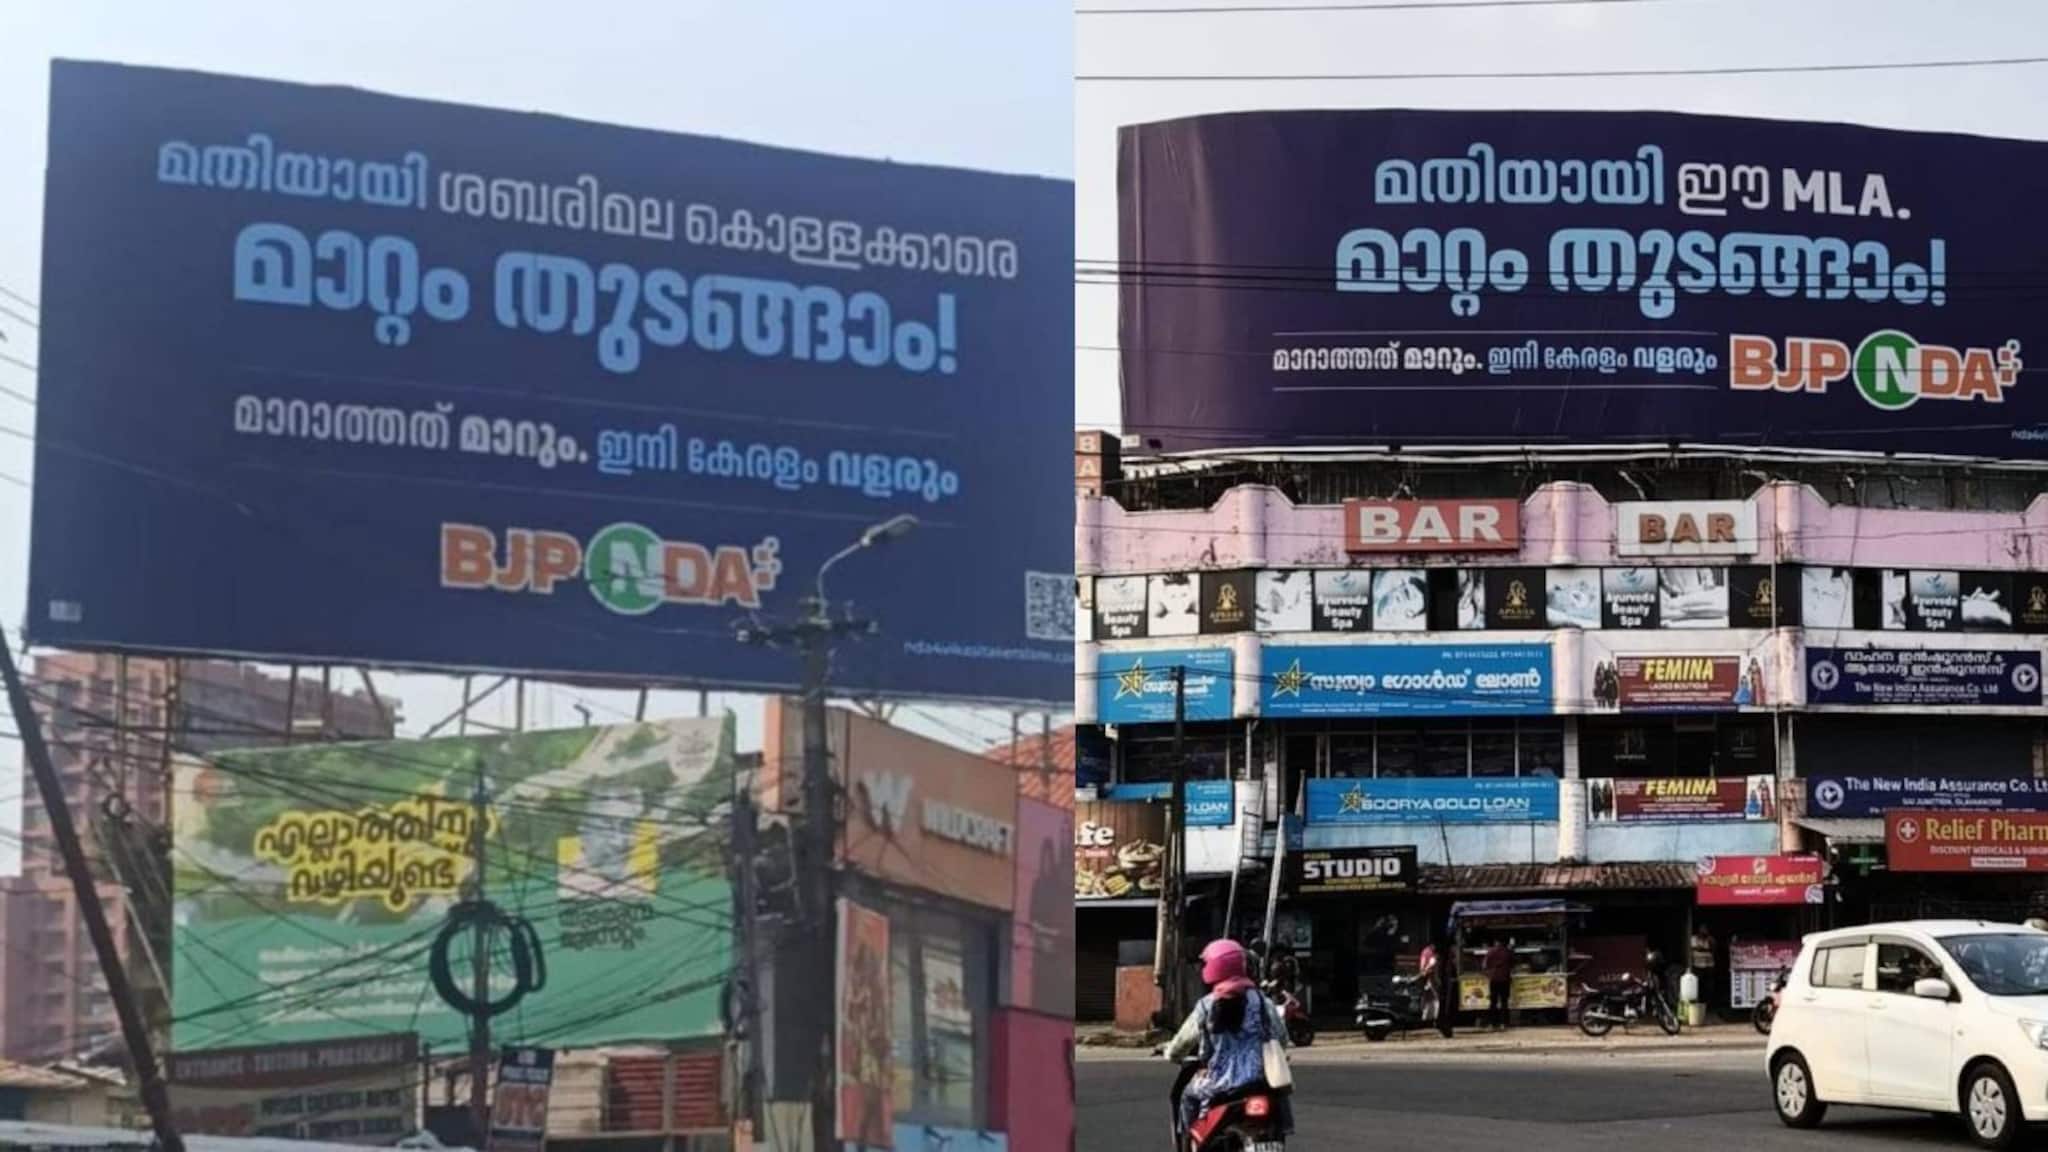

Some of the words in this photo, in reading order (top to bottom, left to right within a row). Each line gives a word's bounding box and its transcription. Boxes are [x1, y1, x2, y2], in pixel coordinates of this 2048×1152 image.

[157, 133, 428, 210] മതിയായി
[438, 174, 675, 241] ശബരിമല
[1374, 142, 1664, 205] മതിയായി
[1677, 162, 1770, 216] ഈ
[1782, 167, 1911, 219] MLA.
[1335, 227, 1529, 317] മാറ്റം
[1549, 227, 1945, 319] തുടങ്ങാം!
[234, 222, 471, 347] മാറ്റം
[494, 250, 957, 374] തുടങ്ങാം!
[1273, 342, 1400, 371] മാറാത്തത്
[1488, 340, 1539, 373] ഇനി
[1545, 347, 1627, 373] കേരളം
[1633, 346, 1718, 374] വളരും
[1729, 333, 1850, 393] BJP
[233, 395, 454, 450] മാറാത്തത്
[598, 424, 679, 475] ഇനി
[688, 440, 819, 490] കേരളം
[828, 449, 959, 502] വളരും
[1360, 505, 1501, 544] BAR
[1639, 513, 1736, 544] BAR
[441, 523, 583, 593] BJP
[1605, 591, 1656, 604] Ayurveda
[1323, 606, 1363, 618] Beauty
[1612, 603, 1650, 616] Beauty
[1918, 606, 1954, 619] Beauty
[1103, 611, 1140, 626] Beauty
[1332, 618, 1354, 630] Spa
[1620, 615, 1641, 628] Spa
[1925, 618, 1946, 630] Spa
[1111, 625, 1132, 638] Spa
[1644, 656, 1714, 681] FEMINA
[1854, 681, 1872, 693] The
[1872, 682, 1893, 693] New
[1894, 682, 1918, 693] India
[1918, 682, 1965, 694] Assurance
[1645, 779, 1717, 796] FEMINA
[1845, 777, 1870, 792] The
[1873, 778, 1900, 792] New
[1903, 778, 1936, 792] India
[1939, 778, 2007, 793] Assurance
[2009, 778, 2032, 793] Co.
[1193, 801, 1229, 814] LOAN
[1433, 797, 1480, 810] GOLD
[1483, 797, 1530, 810] LOAN
[1926, 818, 1985, 841] Relief
[1302, 857, 1401, 879] STUDIO
